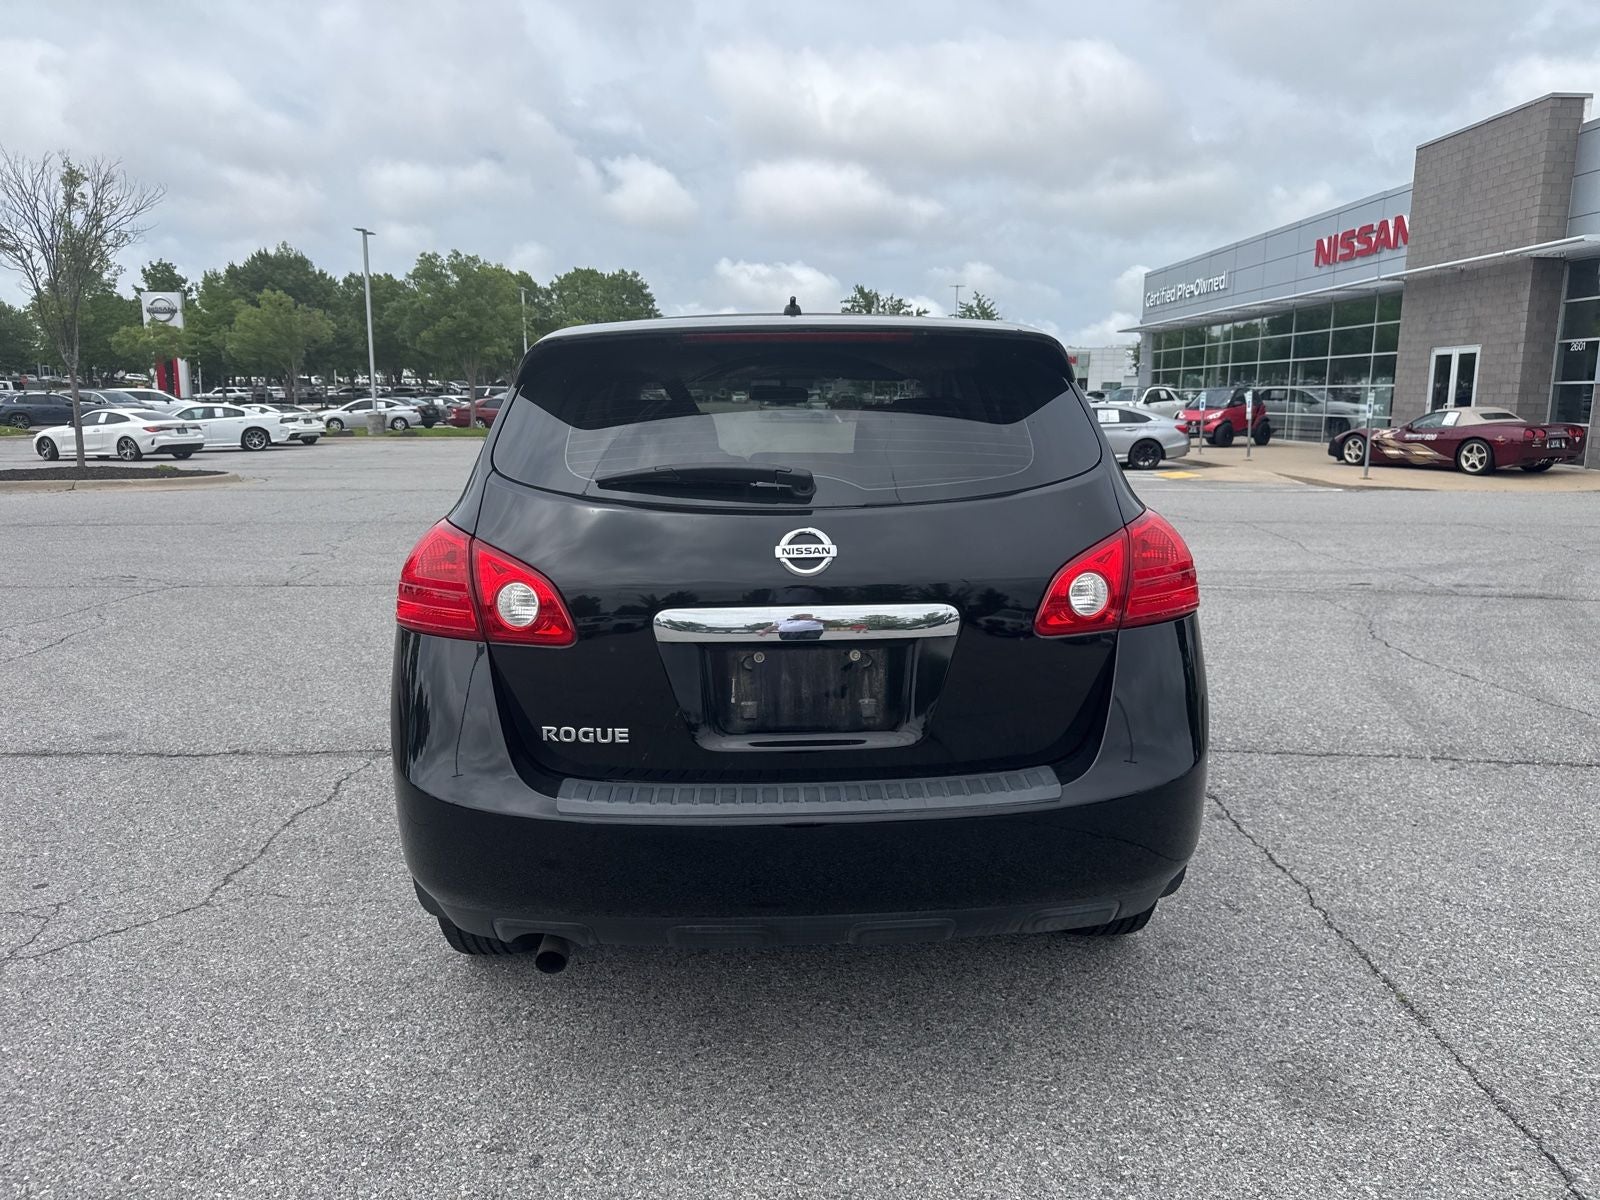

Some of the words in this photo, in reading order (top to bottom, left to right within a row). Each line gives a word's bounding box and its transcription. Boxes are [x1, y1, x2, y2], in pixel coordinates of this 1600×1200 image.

[1314, 215, 1408, 267] NISSAN
[1145, 285, 1175, 307] Certified
[1177, 270, 1227, 300] Pre-Owned
[1570, 341, 1585, 351] 2601
[781, 547, 831, 555] NISSAN
[541, 726, 629, 743] ROGUE
